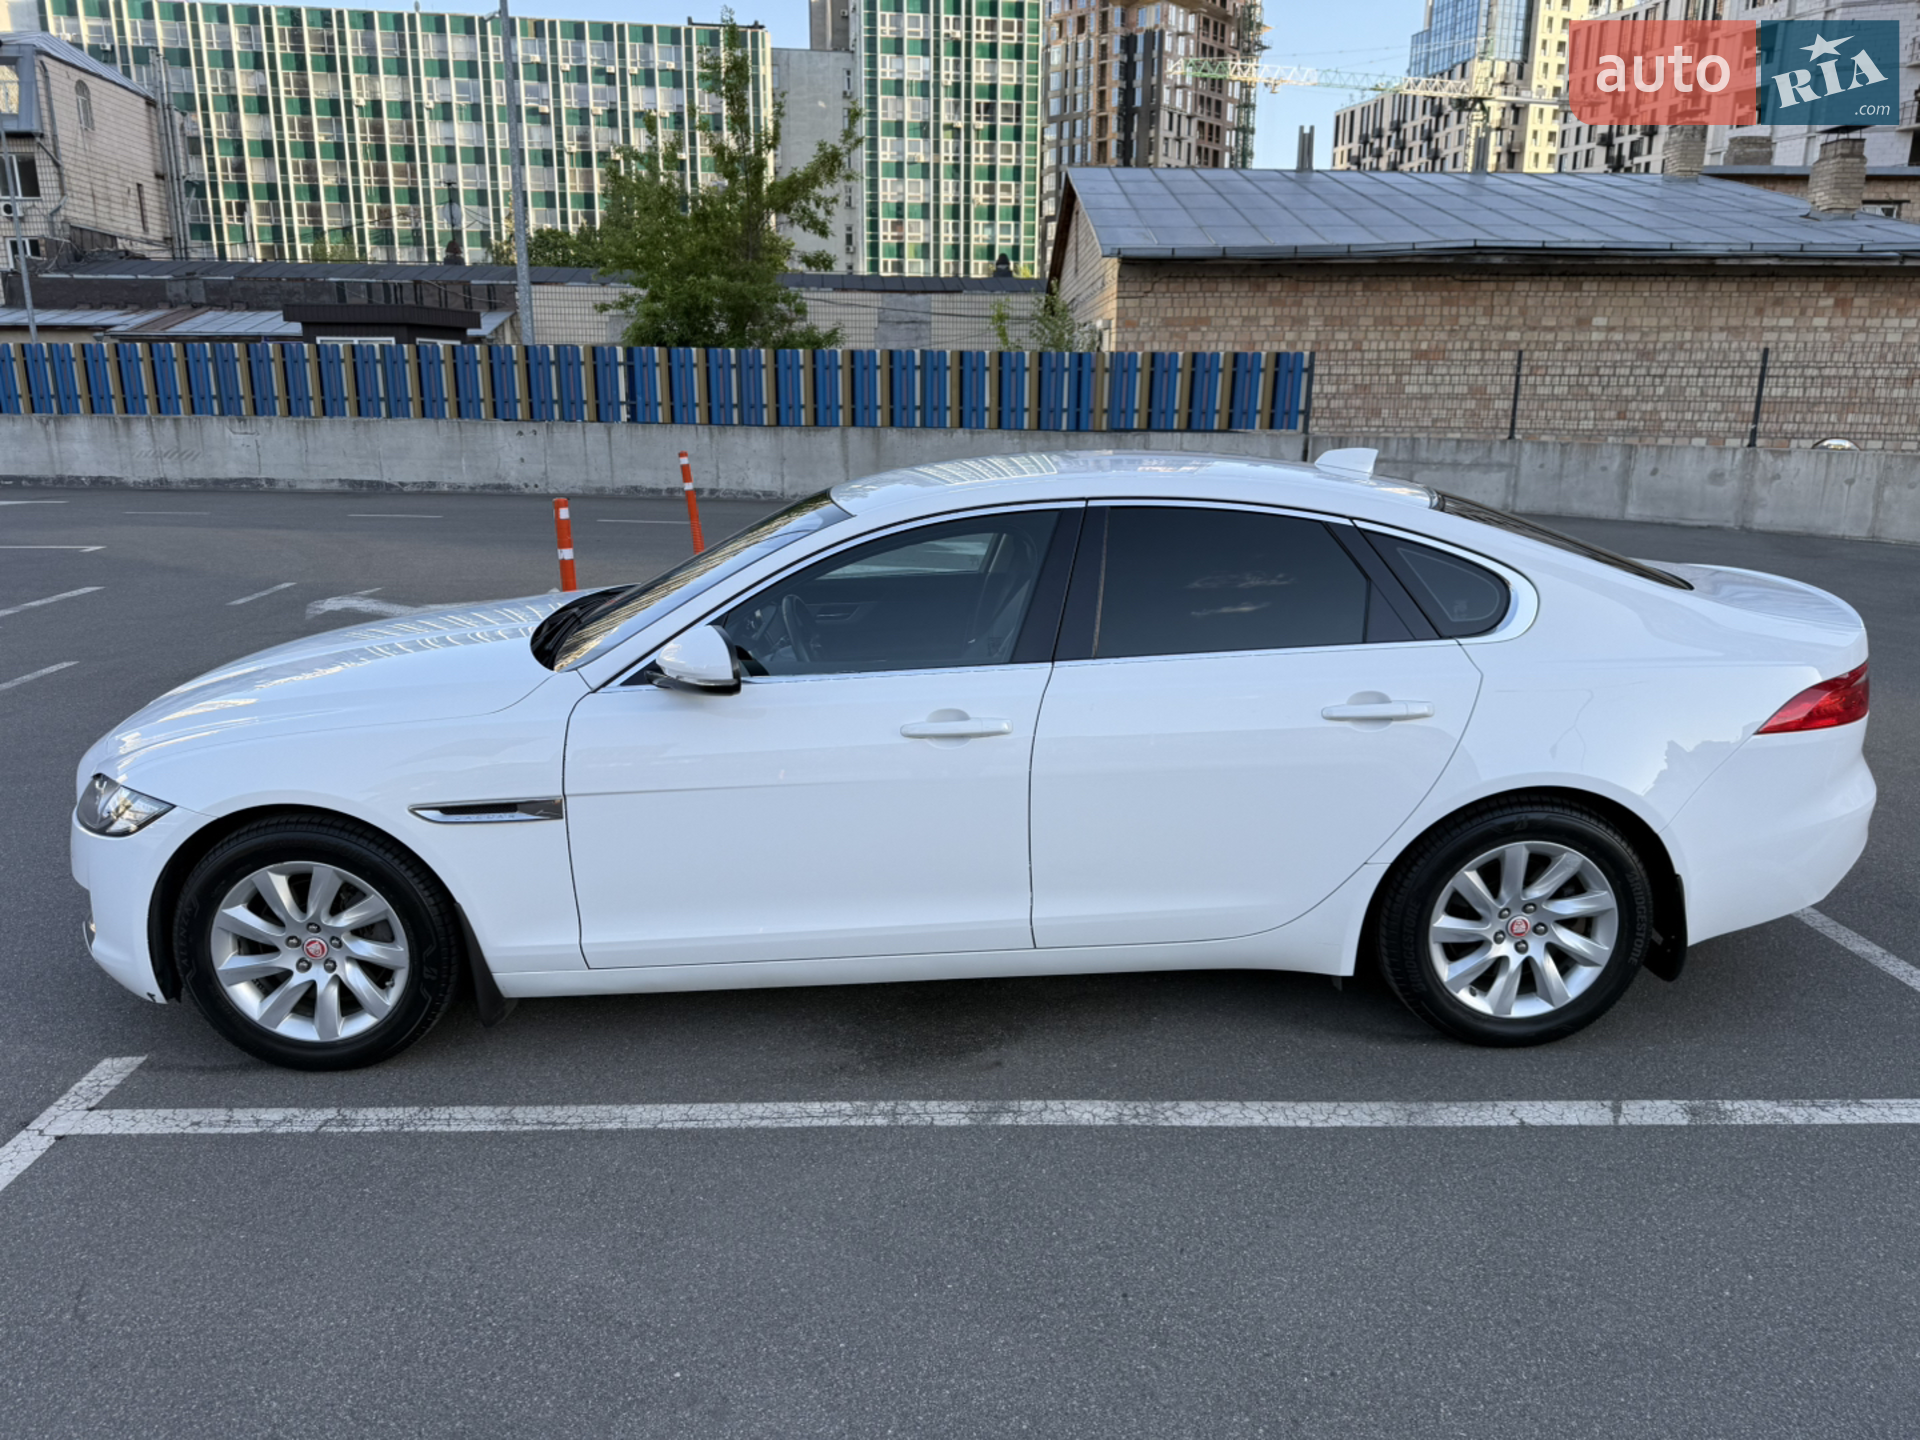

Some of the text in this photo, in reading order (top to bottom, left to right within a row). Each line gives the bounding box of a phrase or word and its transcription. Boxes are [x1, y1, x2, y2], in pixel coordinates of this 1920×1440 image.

[454, 813, 516, 821] JAGUAR
[179, 907, 194, 968] ALENZA
[1624, 870, 1648, 966] BRIDGESTONE
